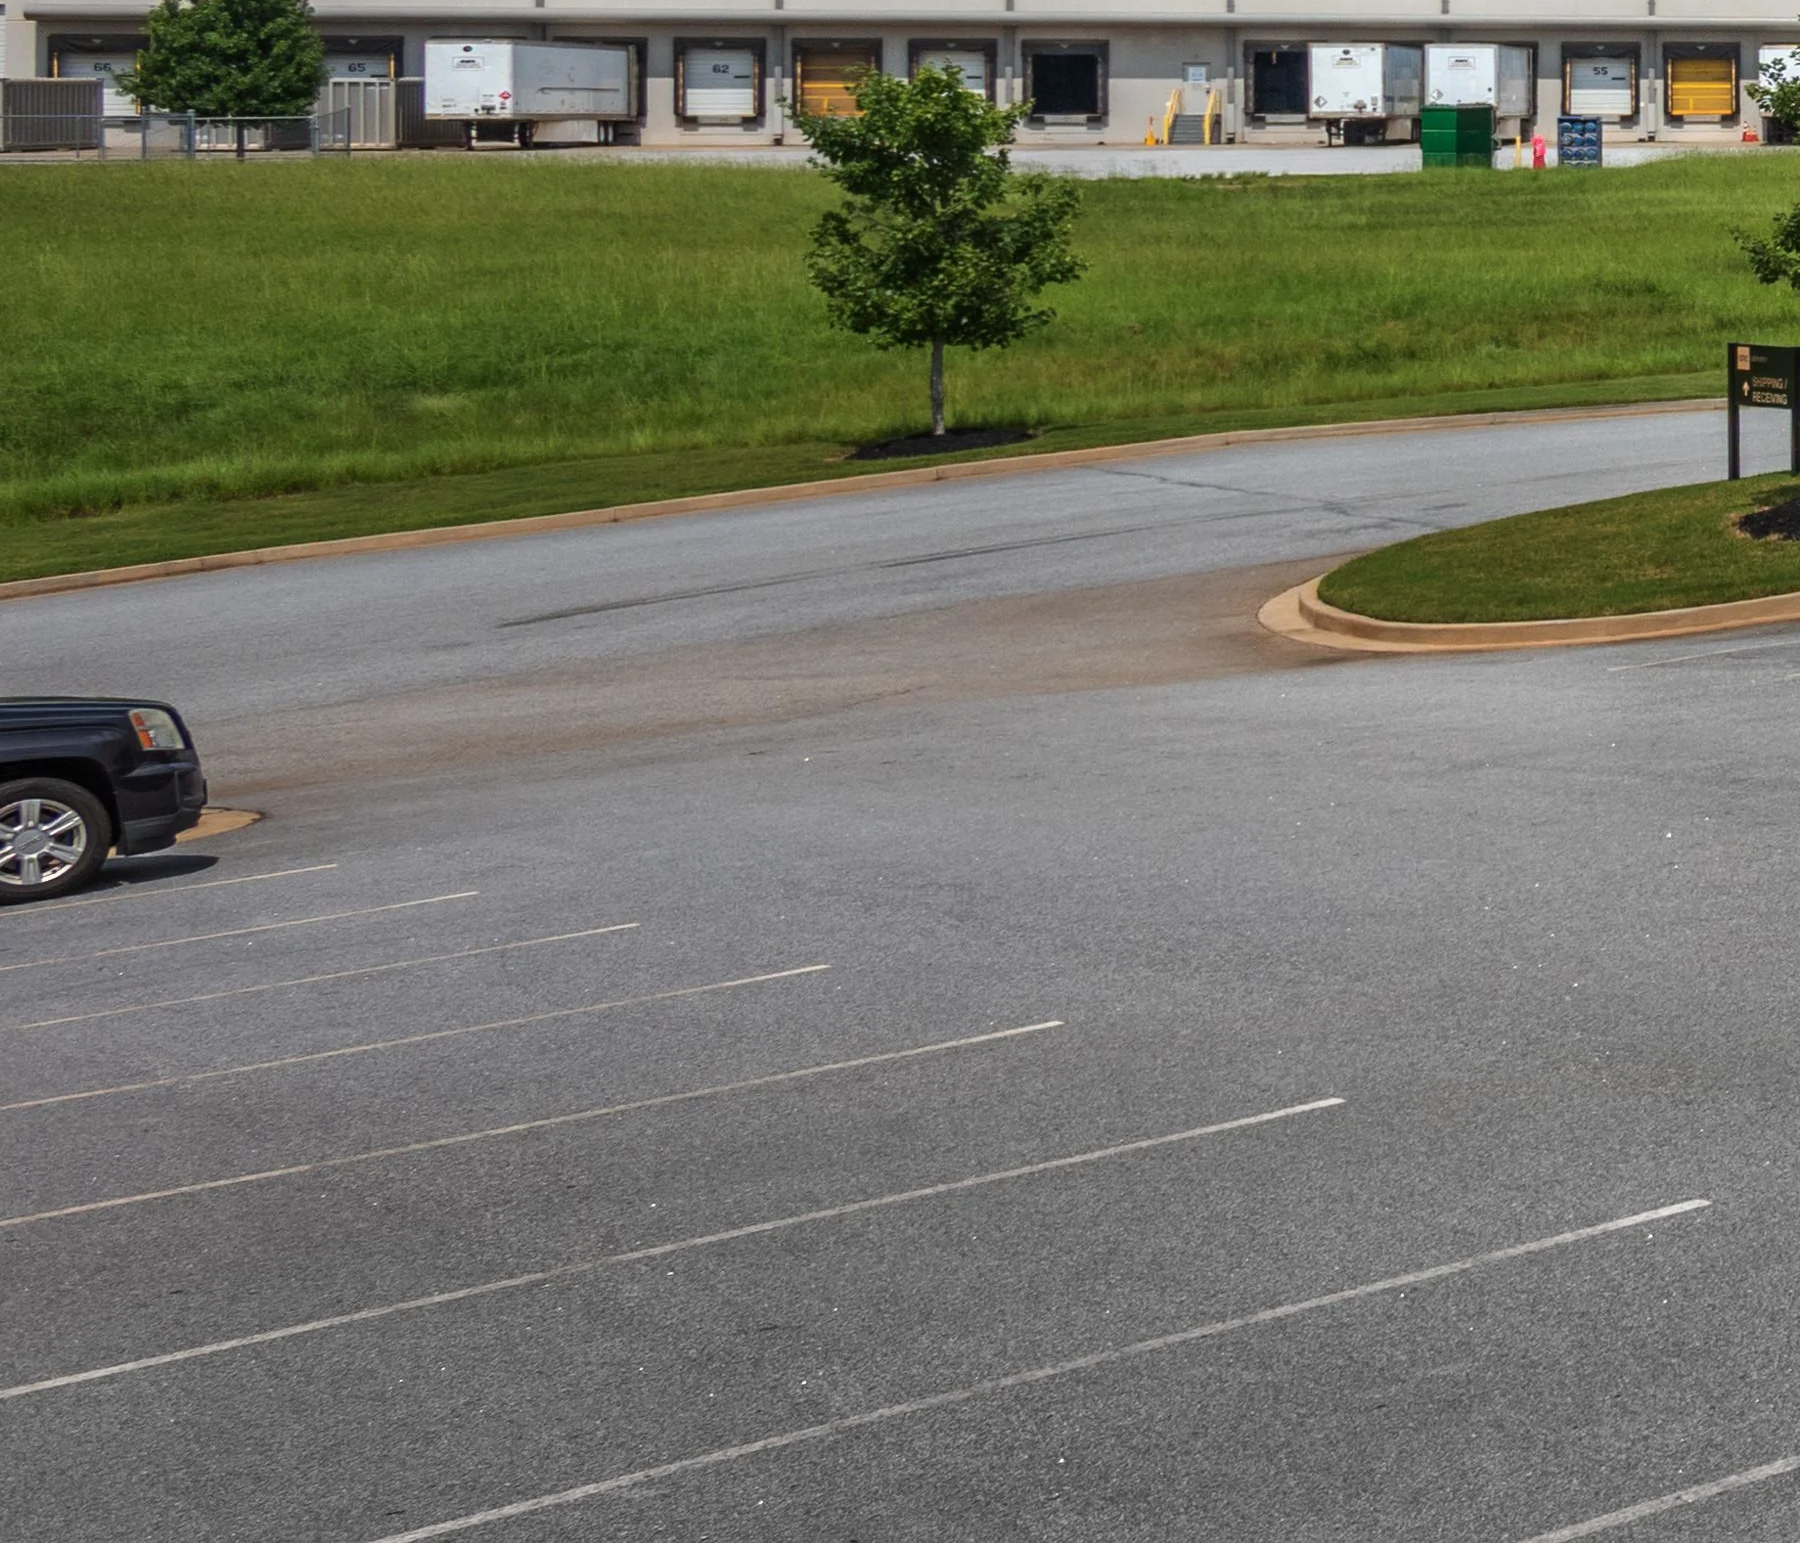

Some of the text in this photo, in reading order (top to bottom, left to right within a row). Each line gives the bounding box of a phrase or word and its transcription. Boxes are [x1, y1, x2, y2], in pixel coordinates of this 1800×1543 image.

[348, 62, 366, 73] 65
[712, 64, 730, 74] 62
[1593, 66, 1609, 75] 55
[1752, 376, 1783, 389] SHIPPING
[1752, 391, 1788, 405] RECEIVING
